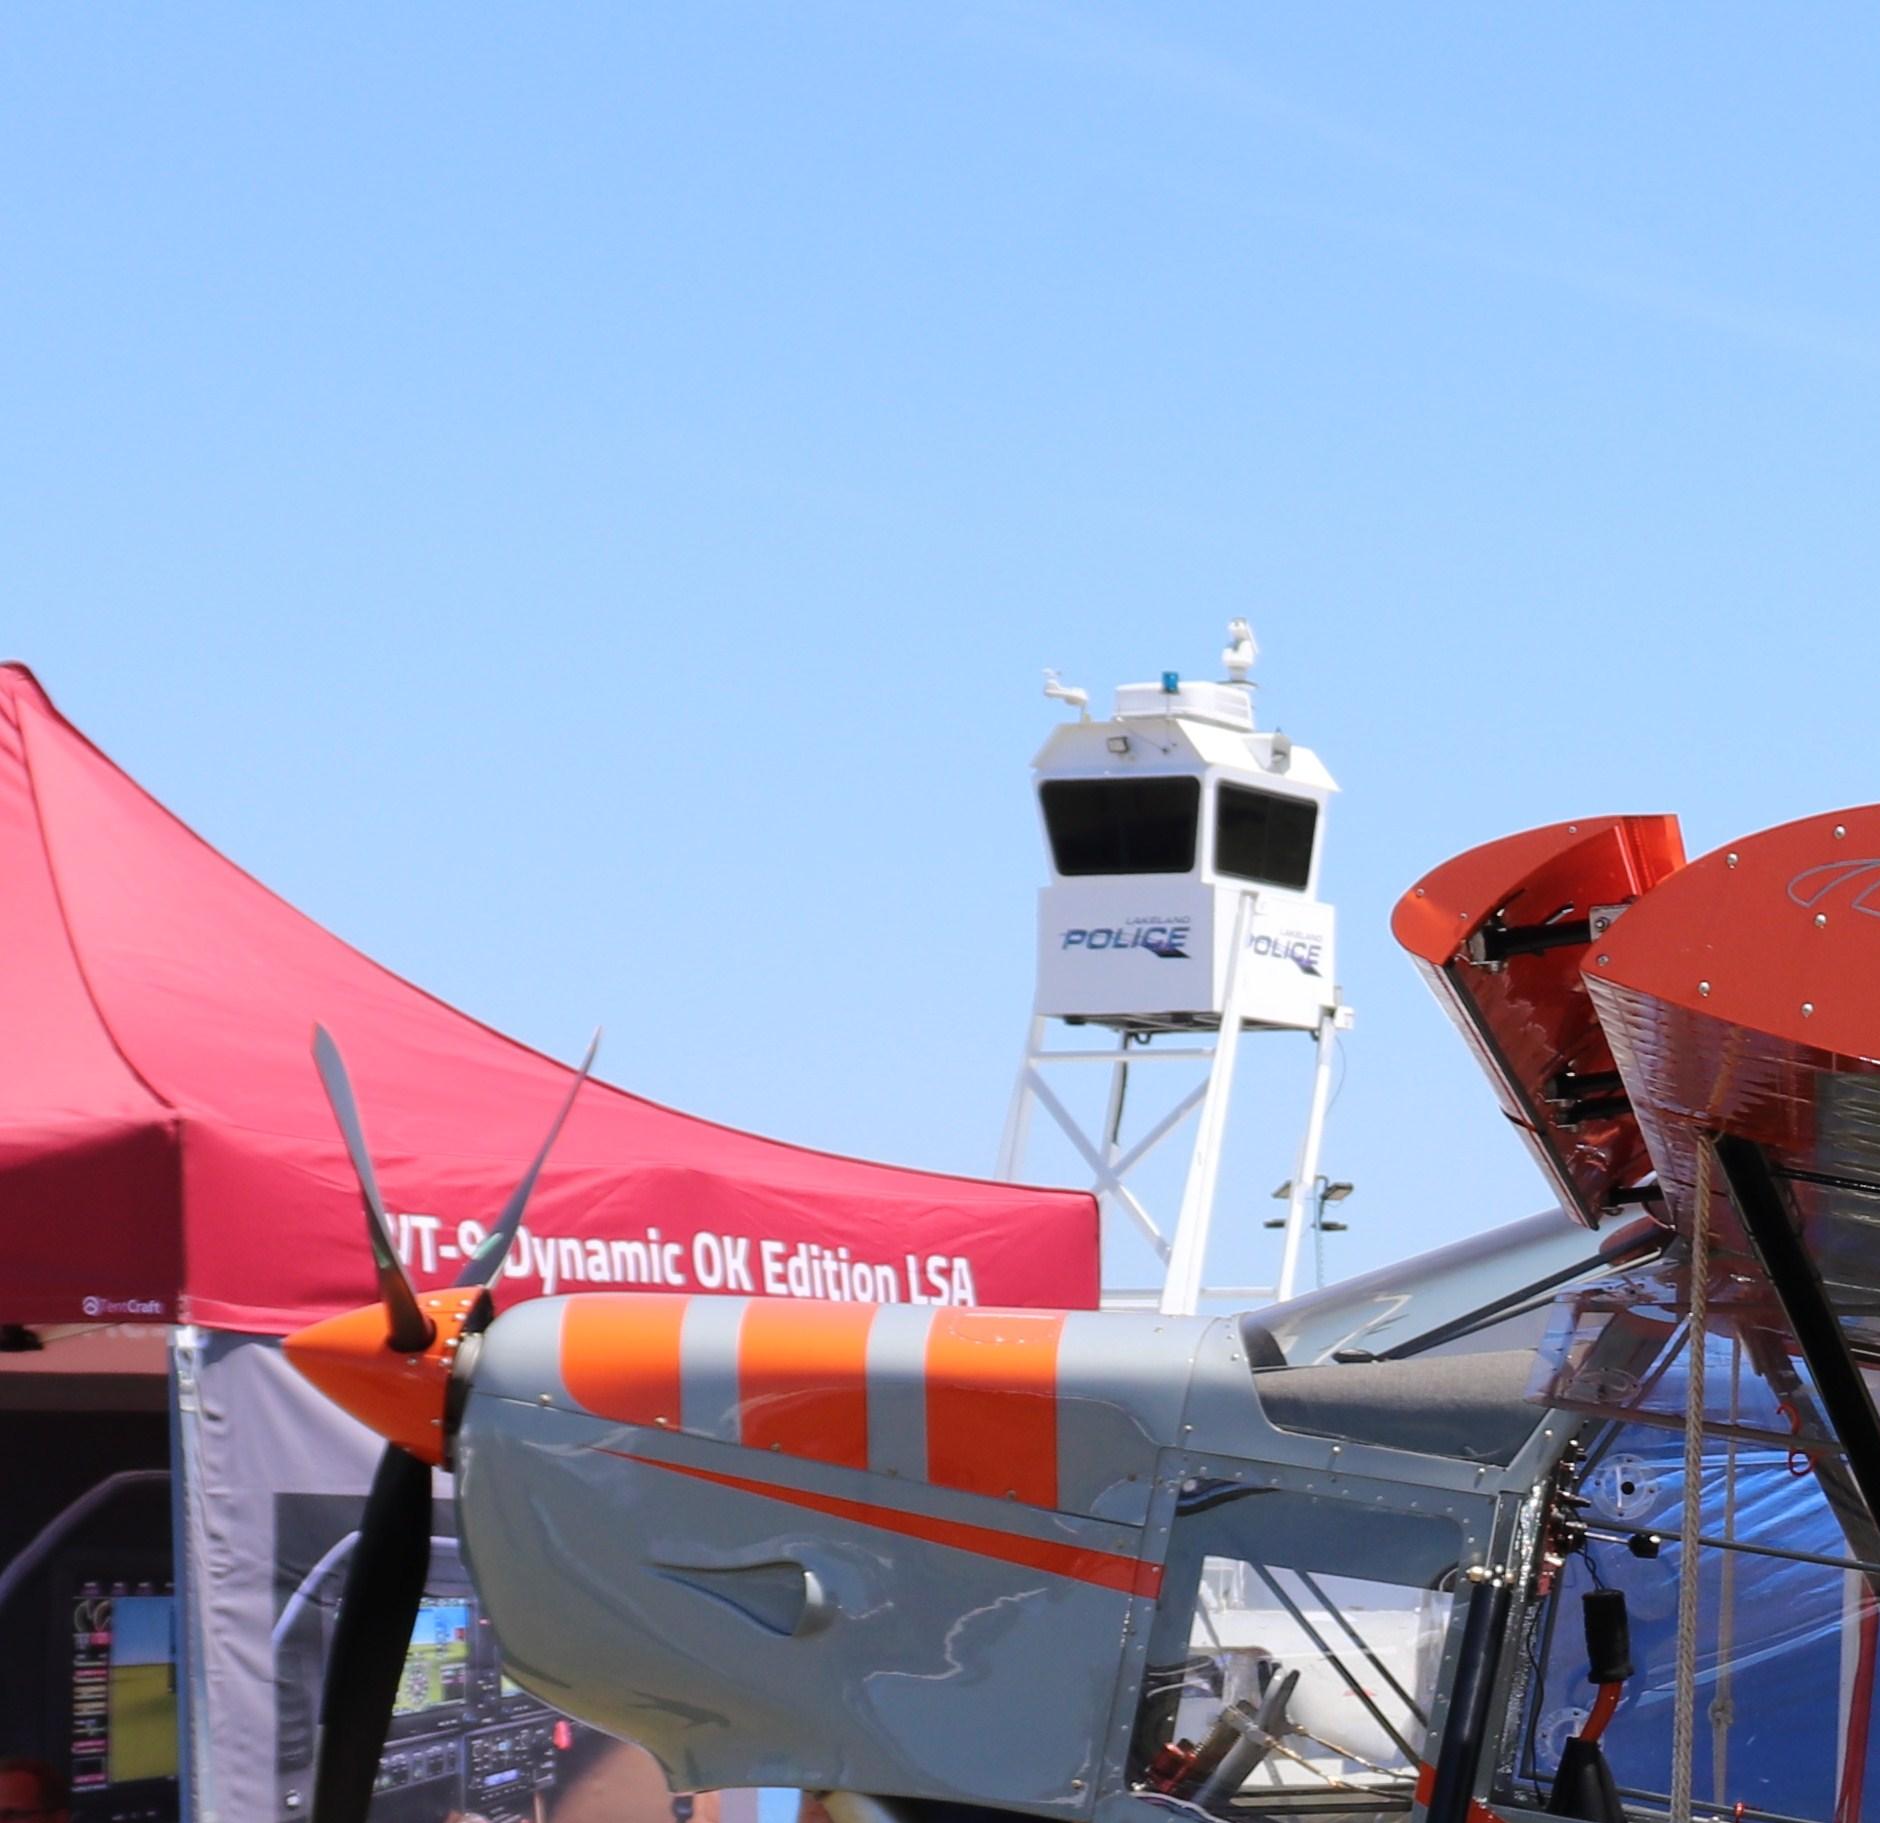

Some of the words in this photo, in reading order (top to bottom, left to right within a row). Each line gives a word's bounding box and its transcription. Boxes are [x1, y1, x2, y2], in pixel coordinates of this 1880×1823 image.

[1062, 926, 1191, 950] POLICE
[503, 1225, 687, 1296] Dynamic
[693, 1231, 754, 1292] OK
[762, 1239, 898, 1303] Edition
[905, 1253, 976, 1307] LSA
